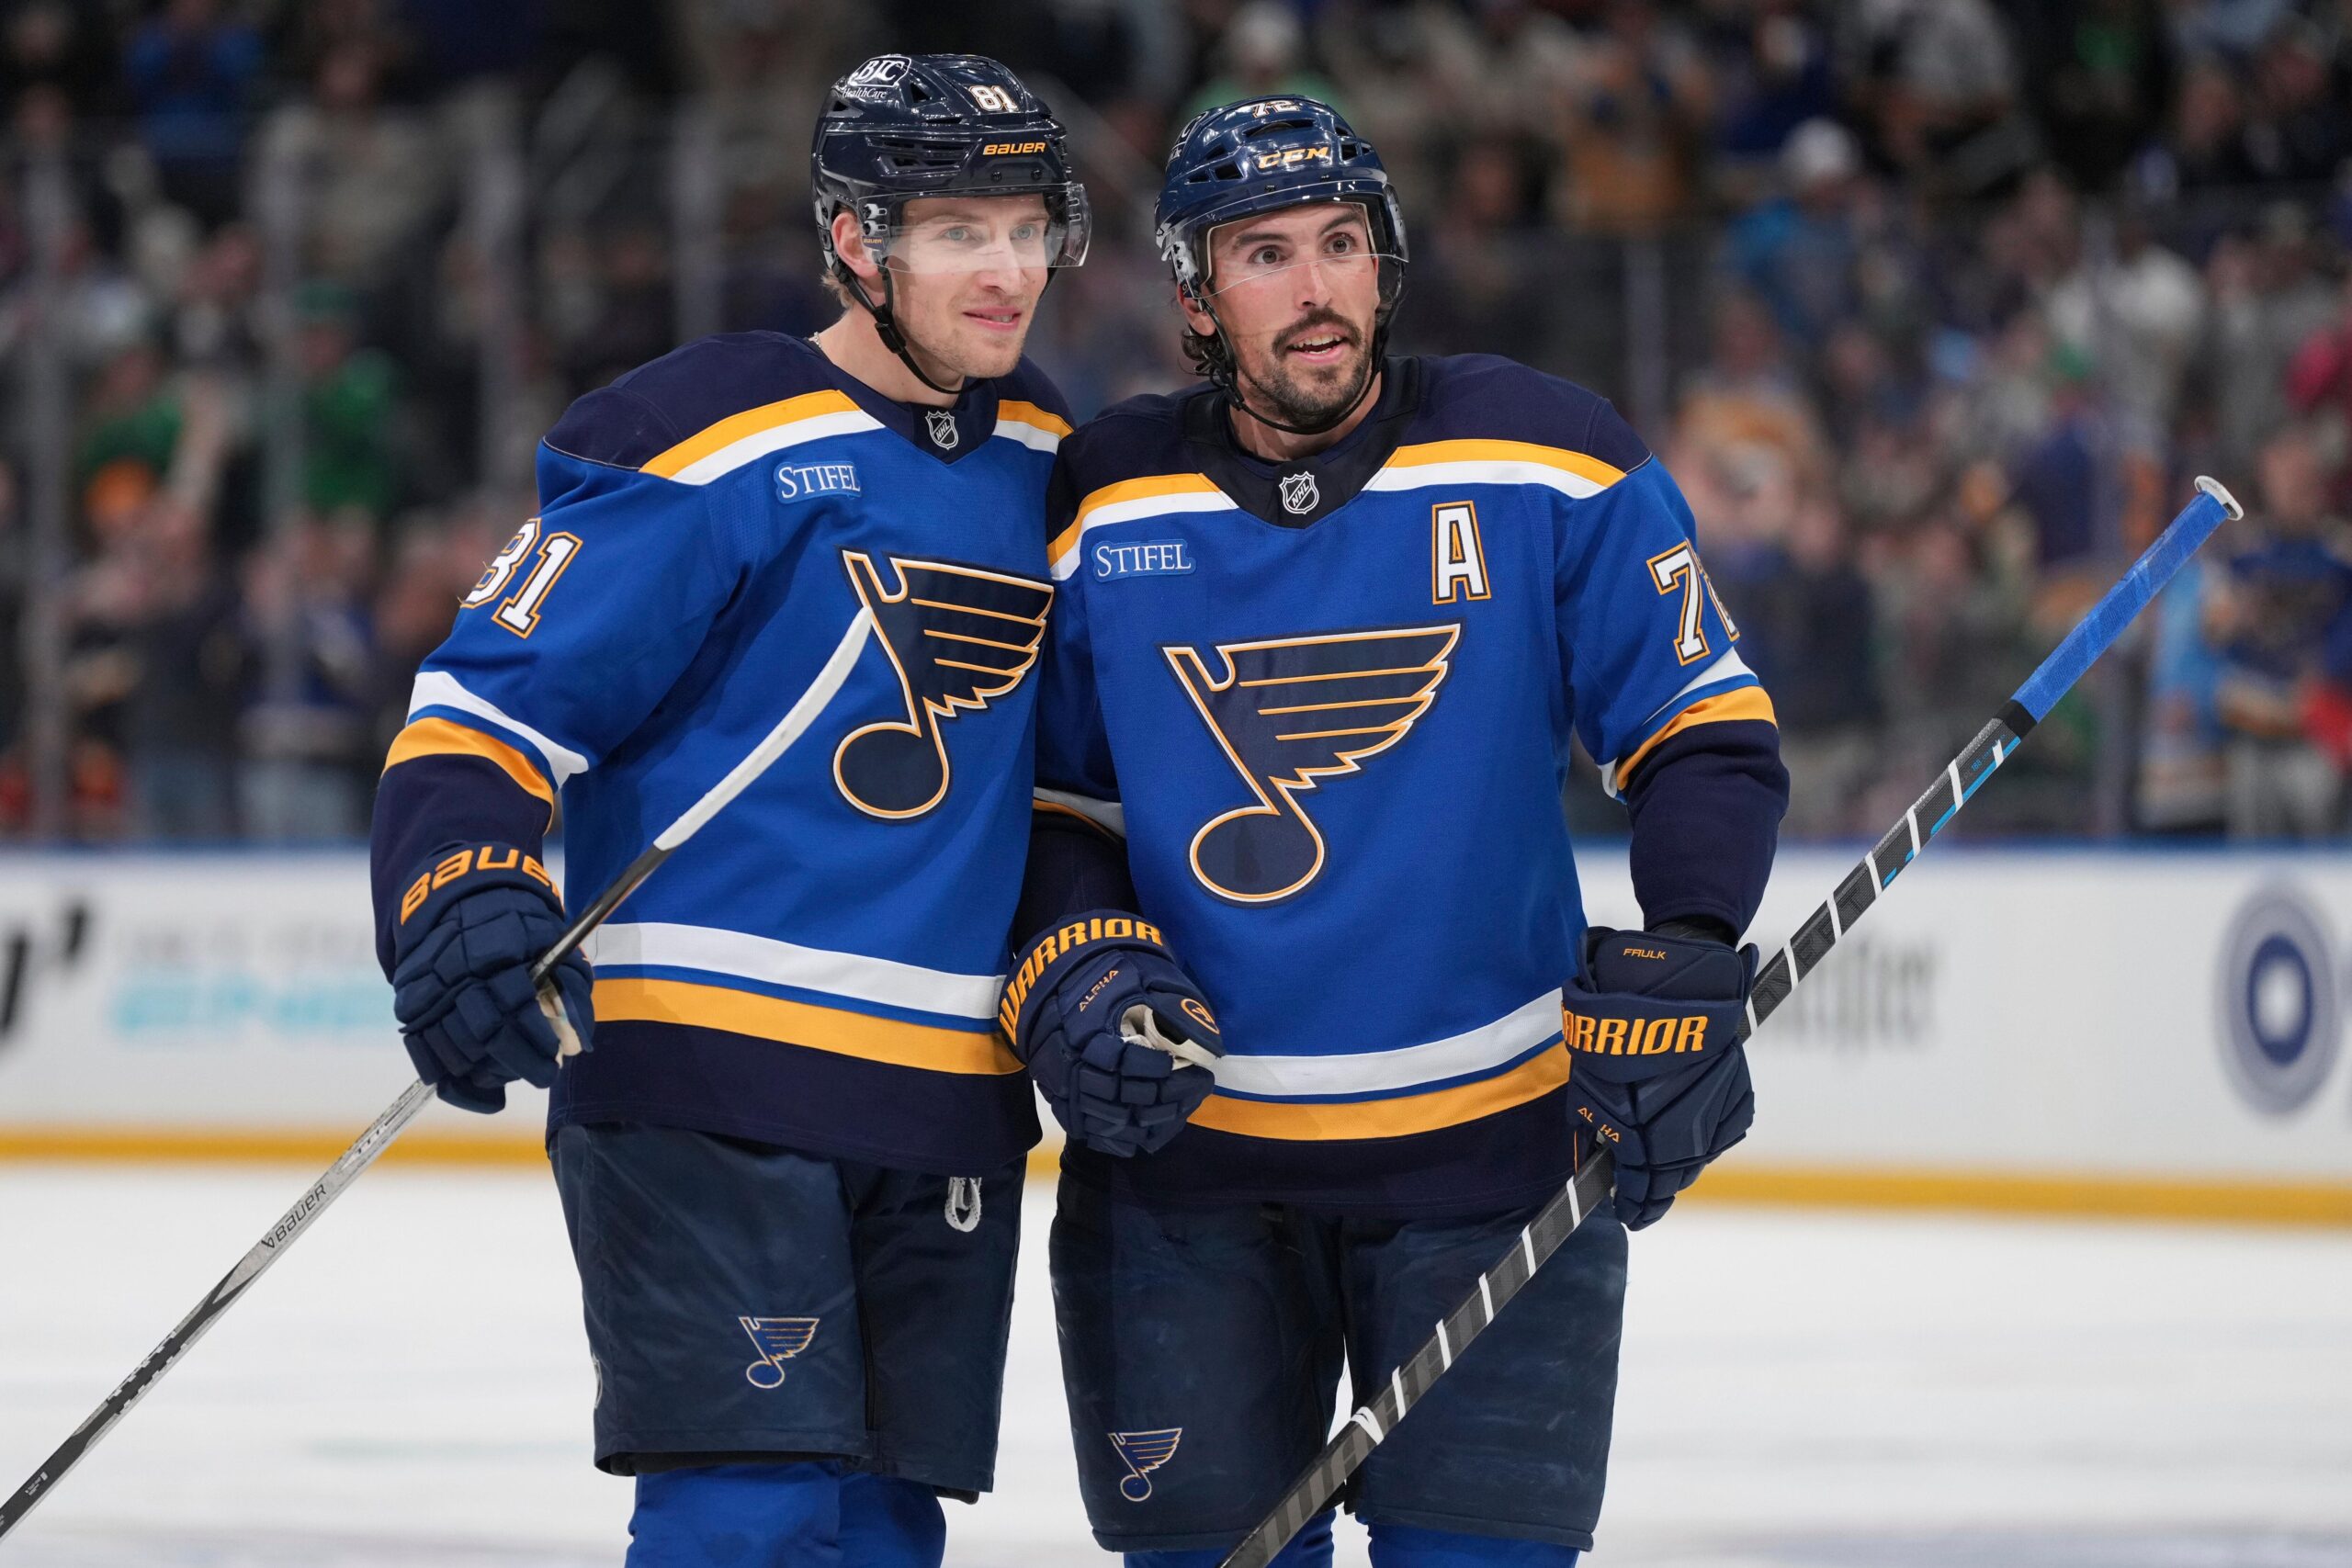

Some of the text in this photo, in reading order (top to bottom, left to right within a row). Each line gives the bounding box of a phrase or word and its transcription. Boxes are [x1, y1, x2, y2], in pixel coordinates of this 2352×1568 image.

[842, 86, 888, 99] HealthCare
[968, 85, 1020, 113] 81
[983, 141, 1046, 155] BAUER
[1259, 146, 1329, 169] CCM
[935, 422, 952, 441] NHL
[778, 465, 861, 499] STIFEL
[1291, 482, 1310, 508] NHL
[1096, 543, 1192, 577] STIFEL
[1431, 500, 1492, 605] A
[460, 517, 584, 639] 81
[1623, 948, 1667, 960] FAULK
[999, 919, 1164, 1045] WARRIOR
[1080, 969, 1119, 1012] ALPHA
[1561, 1000, 1709, 1055] ARRIOR
[1577, 1106, 1622, 1144] ALHA
